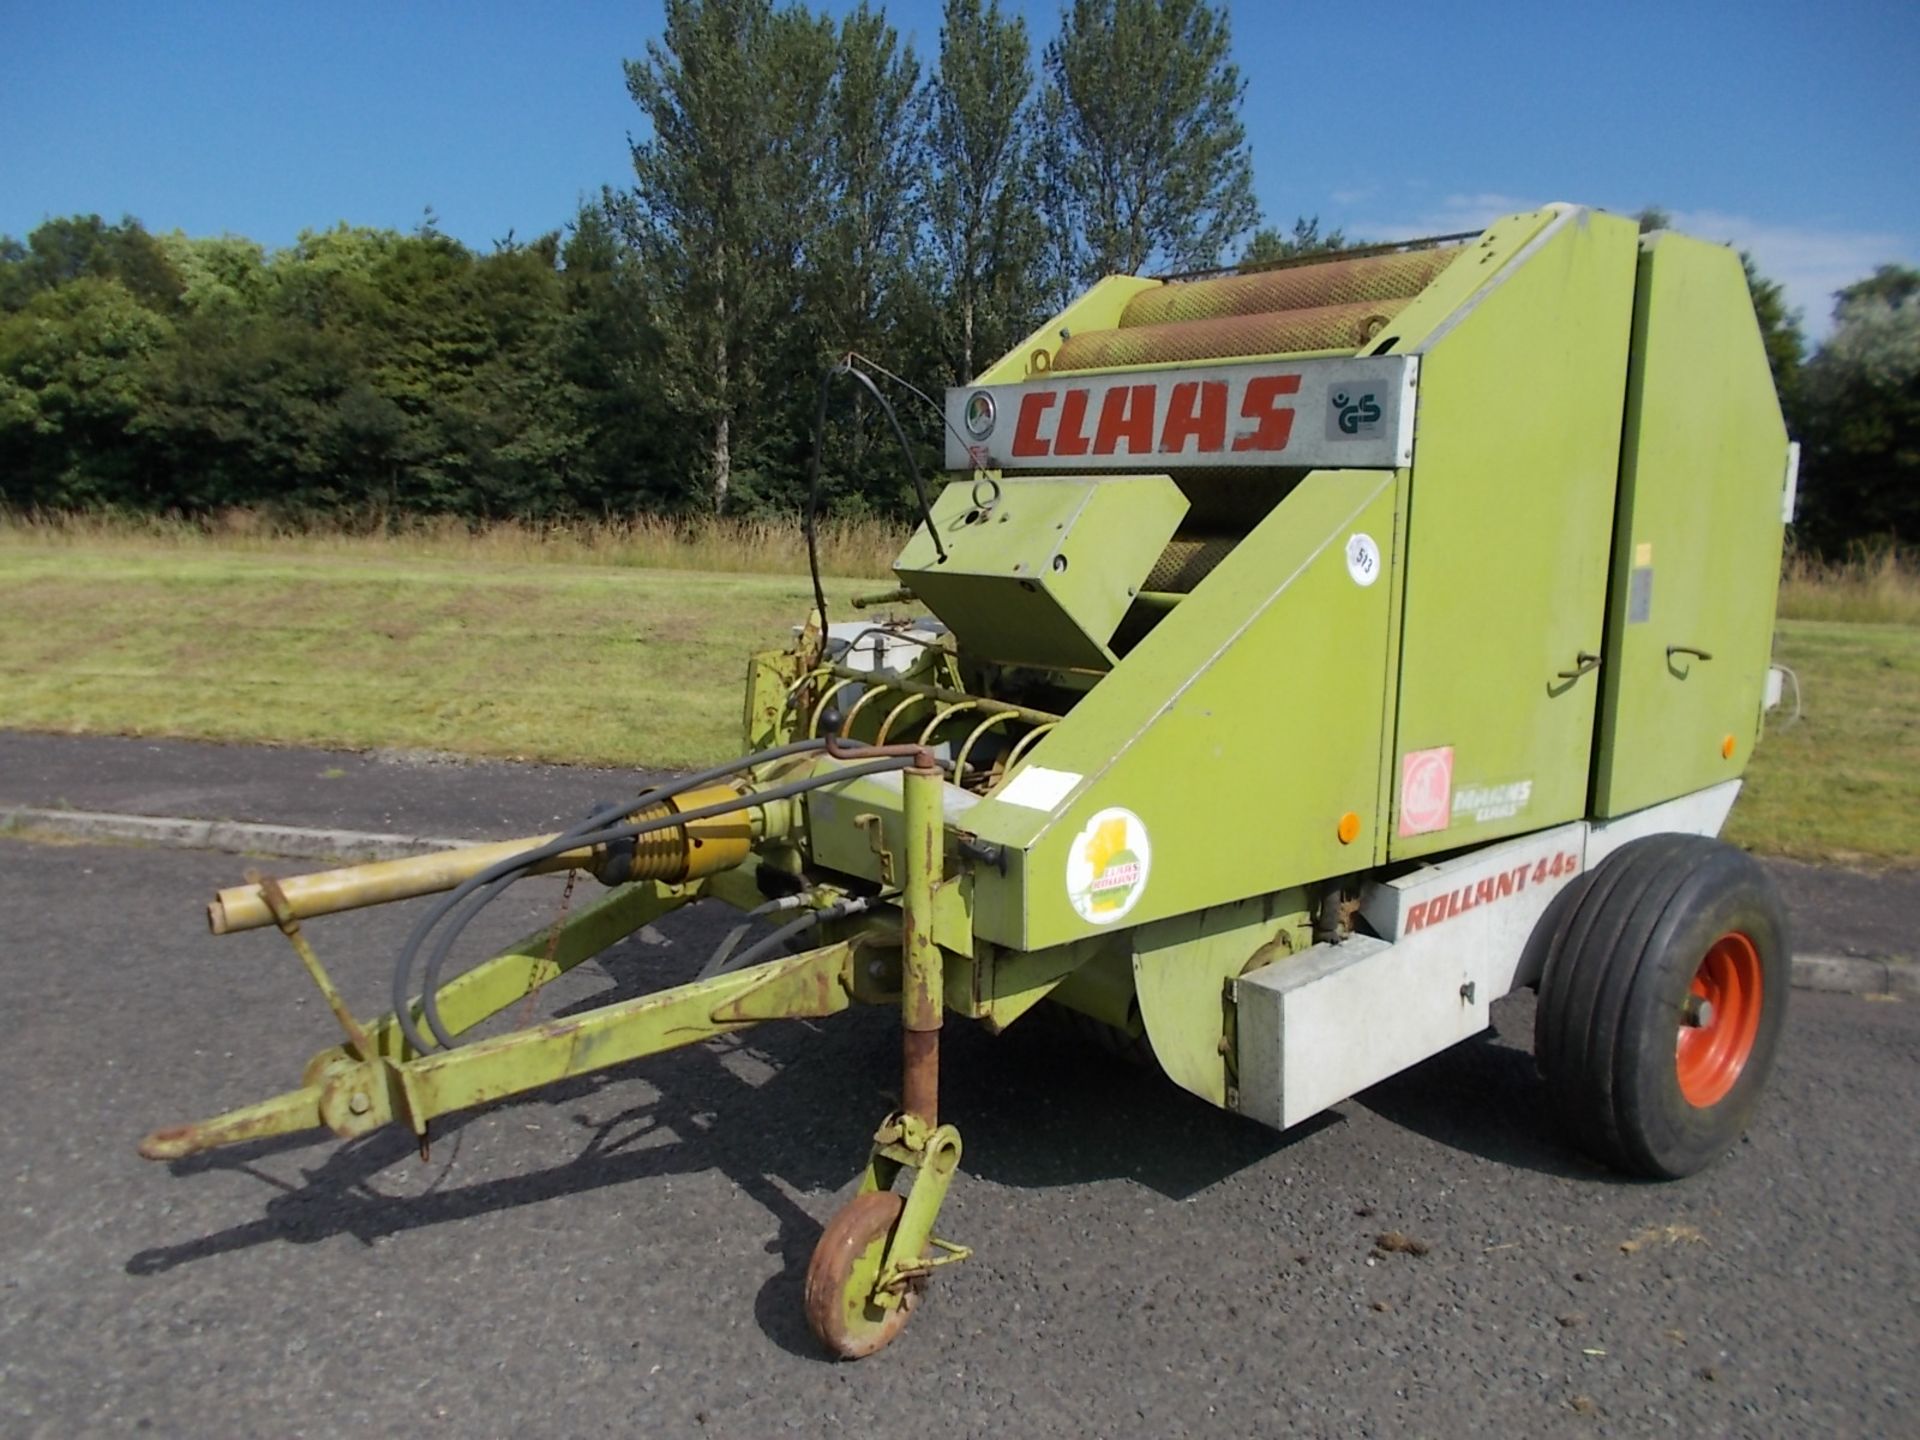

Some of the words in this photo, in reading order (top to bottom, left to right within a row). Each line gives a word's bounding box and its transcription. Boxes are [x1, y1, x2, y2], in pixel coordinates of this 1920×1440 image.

[1012, 374, 1302, 457] CLAAS
[1338, 393, 1381, 434] GS
[1404, 862, 1532, 936] ROLLANT
